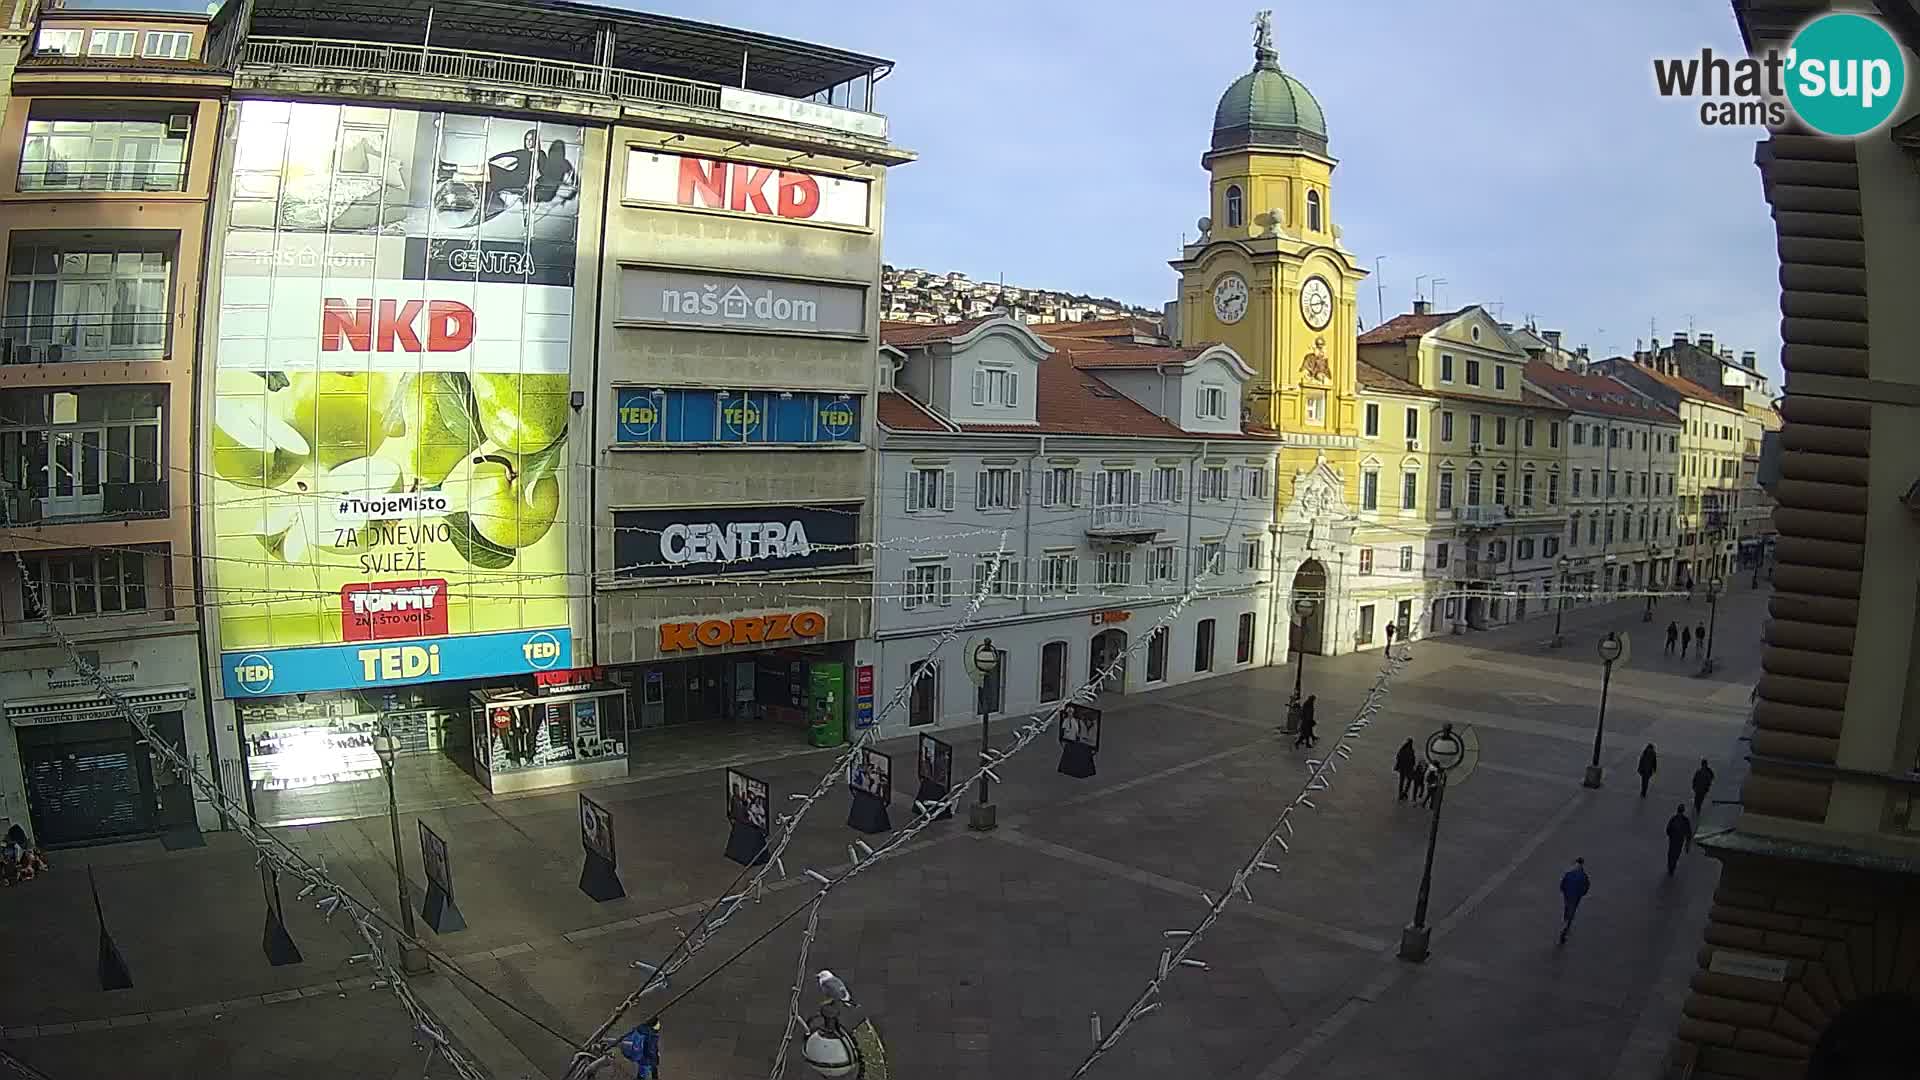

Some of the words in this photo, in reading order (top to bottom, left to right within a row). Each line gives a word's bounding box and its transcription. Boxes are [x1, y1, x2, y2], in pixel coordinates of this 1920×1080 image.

[676, 156, 820, 219] NKD
[448, 248, 536, 275] CENTRA
[662, 283, 719, 316] naš
[754, 289, 817, 322] dom
[321, 297, 476, 353] NKD
[619, 407, 658, 425] TEDi
[724, 408, 760, 425] TEDi
[820, 410, 853, 426] TEDi
[339, 496, 447, 516] #TvojeMisto
[335, 527, 358, 548] ZA
[366, 523, 451, 547] DNEVNO
[659, 520, 811, 562] CENTRA
[360, 546, 427, 574] SVJEŽE
[348, 585, 440, 614] TOMMY
[379, 613, 401, 625] ŠTO
[659, 611, 826, 652] KORZO
[358, 643, 441, 681] TEDi
[522, 641, 560, 660] TEDi
[234, 664, 274, 683] TEDi
